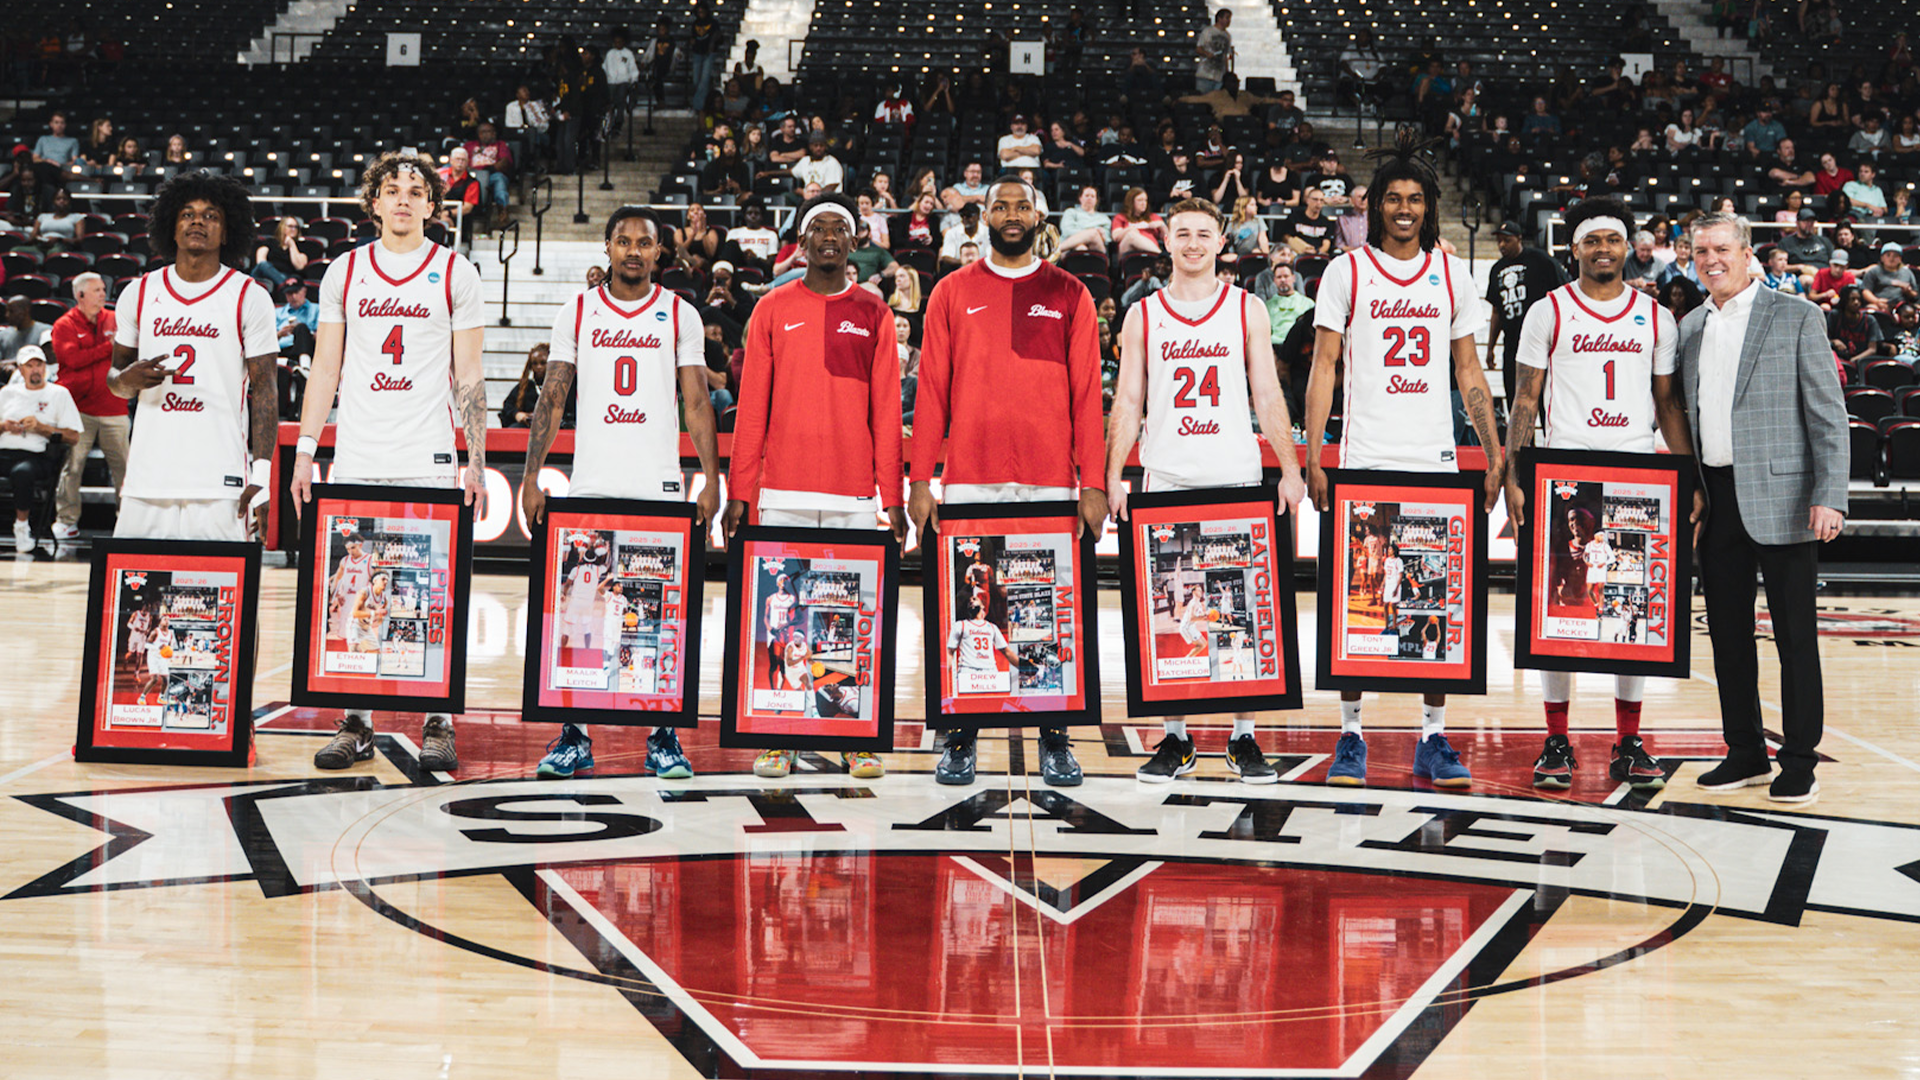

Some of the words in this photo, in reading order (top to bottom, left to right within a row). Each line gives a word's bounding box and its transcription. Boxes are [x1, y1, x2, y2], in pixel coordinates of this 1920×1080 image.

[400, 44, 407, 56] G
[1024, 52, 1031, 64] H
[1634, 63, 1640, 74] I
[358, 298, 430, 318] Valdosta
[1028, 304, 1063, 320] Blazers
[1370, 299, 1440, 319] Valdosta
[154, 317, 220, 338] Valdosta
[592, 328, 662, 348] Valdosta
[381, 324, 404, 365] 4
[1161, 339, 1230, 361] Valdosta
[1382, 326, 1430, 367] 23
[1572, 333, 1643, 354] Valdosta
[172, 344, 196, 384] 2
[370, 372, 413, 391] State
[614, 356, 637, 396] 0
[1174, 365, 1220, 408] 24
[1386, 374, 1429, 394] State
[1603, 360, 1615, 400] 1
[162, 392, 204, 412] State
[604, 404, 646, 424] State
[1587, 408, 1630, 427] State
[1178, 416, 1220, 436] State
[1447, 515, 1465, 606] GREEN
[584, 571, 592, 584] 0
[1648, 534, 1669, 640] MCKEY
[428, 568, 447, 644] PIRES
[1250, 522, 1275, 676] BATCHELOR
[214, 586, 236, 683] BROWN
[1055, 586, 1073, 663] MILLS
[1446, 612, 1464, 651] JR.
[658, 584, 681, 694] LEITCH
[855, 602, 875, 686] JONES
[973, 637, 989, 650] 33
[1158, 668, 1209, 676] BATCHELOR
[210, 689, 228, 730] JR.
[440, 787, 1617, 868] STATE
